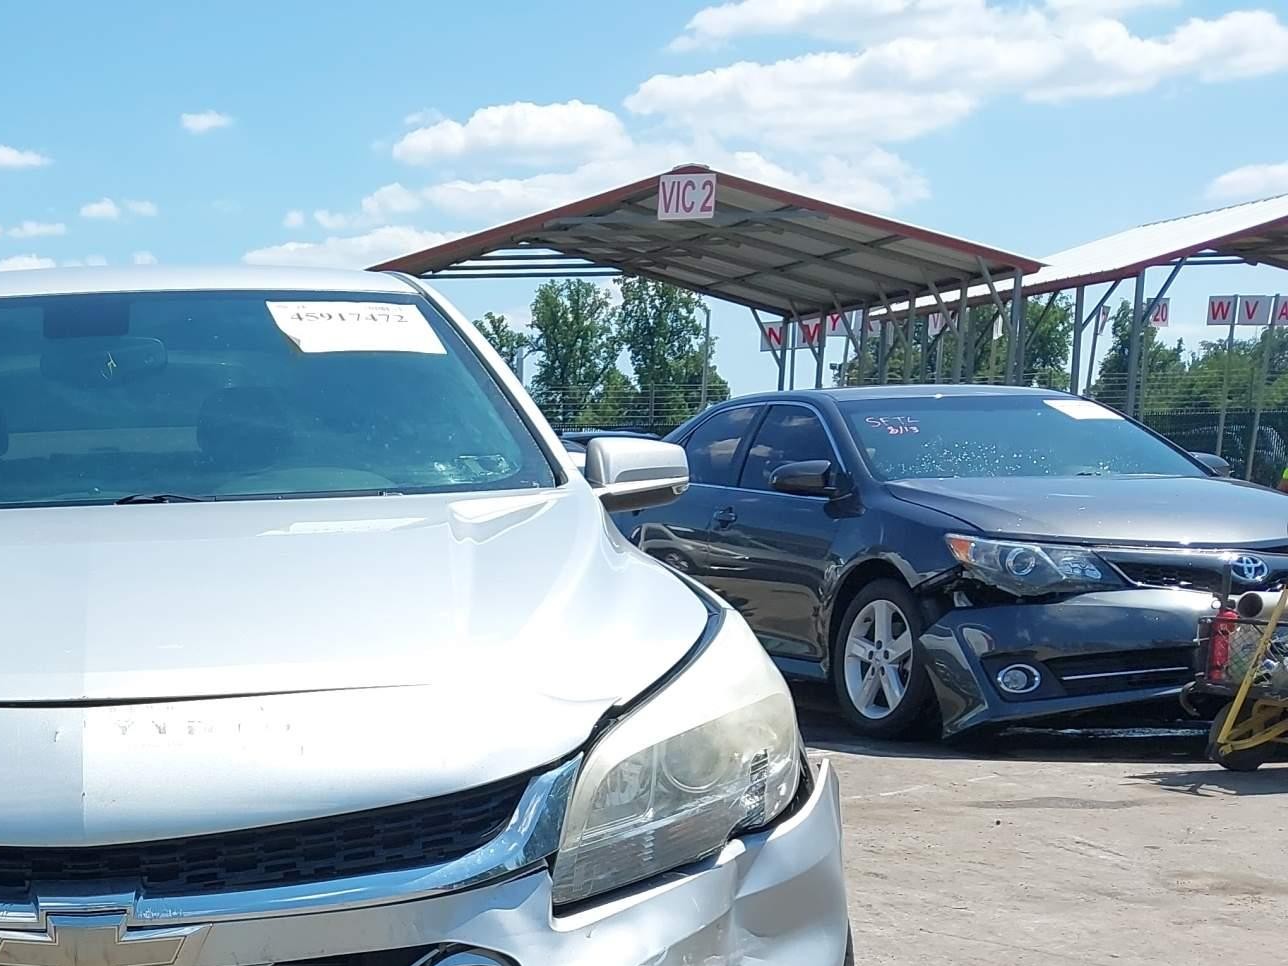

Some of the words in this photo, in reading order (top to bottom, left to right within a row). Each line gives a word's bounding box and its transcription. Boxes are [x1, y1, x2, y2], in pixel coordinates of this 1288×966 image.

[661, 180, 696, 213] VIC
[700, 180, 713, 212] 2
[290, 311, 409, 323] 45917472
[1212, 301, 1231, 320] W
[1245, 301, 1259, 320] V
[830, 313, 841, 331] Y
[768, 326, 783, 345] N
